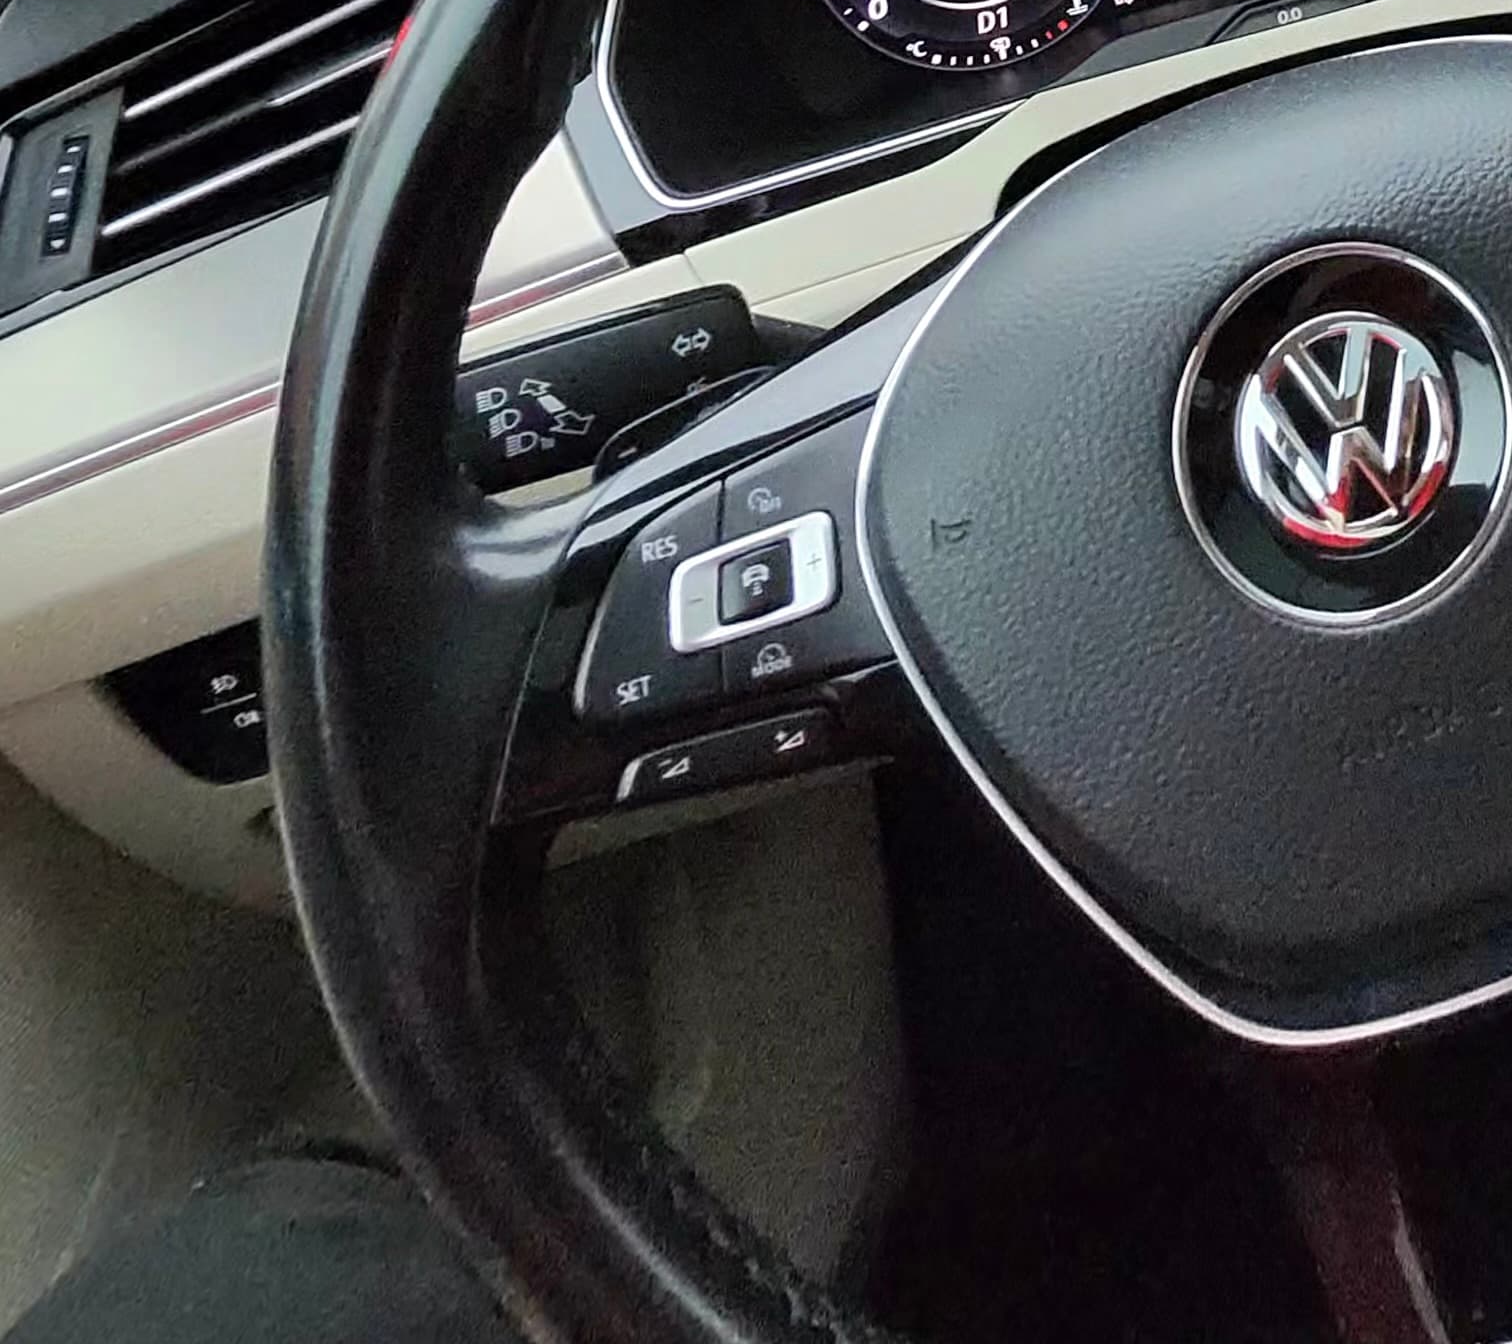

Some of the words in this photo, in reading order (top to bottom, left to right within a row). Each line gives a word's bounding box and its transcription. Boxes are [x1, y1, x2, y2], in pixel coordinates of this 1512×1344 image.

[977, 6, 1010, 35] D1
[1277, 7, 1303, 24] 0.0
[641, 534, 679, 563] RES
[751, 655, 793, 678] MODE
[616, 674, 653, 706] SET
